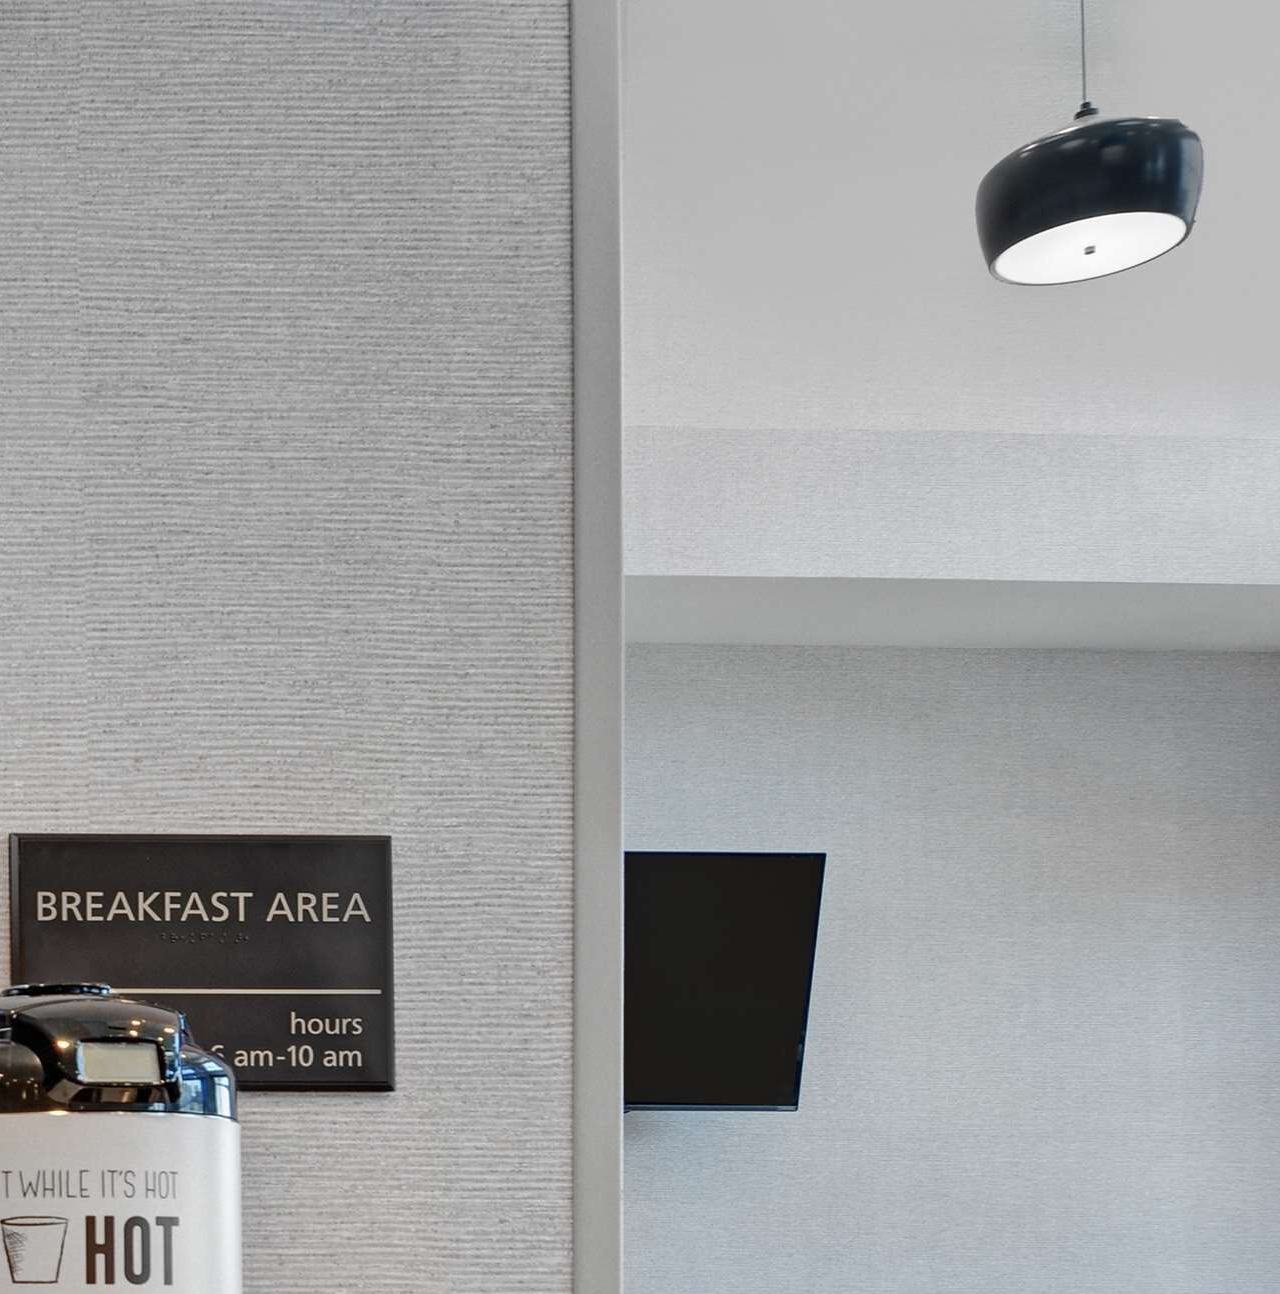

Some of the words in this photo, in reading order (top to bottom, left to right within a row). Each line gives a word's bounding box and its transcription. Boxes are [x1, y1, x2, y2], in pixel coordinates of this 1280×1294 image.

[37, 891, 254, 922] BREAKFAST
[266, 892, 371, 923] AREA
[290, 1012, 363, 1035] hours
[234, 1045, 314, 1067] am-10
[322, 1050, 362, 1067] am
[19, 1169, 90, 1198] WHILE
[101, 1169, 136, 1198] IT'S
[145, 1170, 178, 1199] HOT
[85, 1215, 180, 1286] HOT
